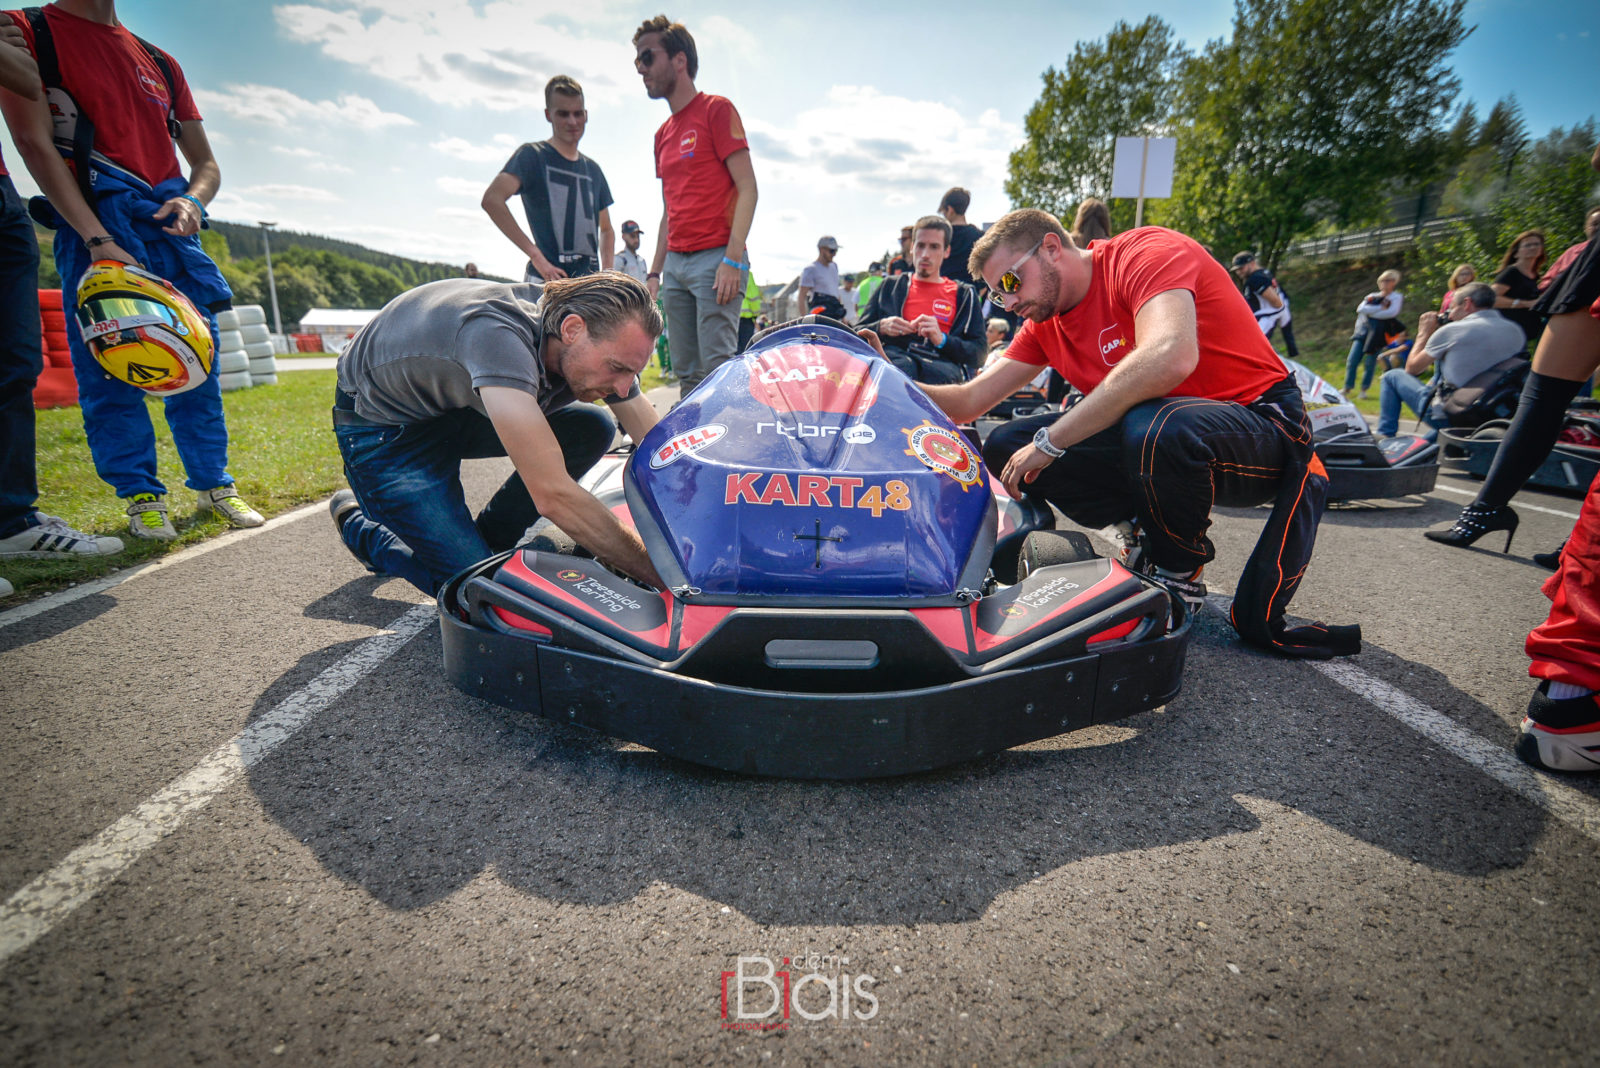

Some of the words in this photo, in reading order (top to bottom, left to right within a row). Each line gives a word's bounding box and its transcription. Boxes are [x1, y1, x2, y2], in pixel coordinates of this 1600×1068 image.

[93, 318, 120, 334] lotto
[658, 429, 717, 462] BELL
[912, 428, 929, 445] ROYAL
[929, 427, 976, 464] AUTOMOBILE
[966, 464, 977, 480] CLUB
[919, 453, 961, 478] BELGIUM
[572, 581, 624, 612] karting
[584, 576, 641, 610] Teesside
[1012, 576, 1069, 604] Teesside
[1024, 582, 1080, 609] karting
